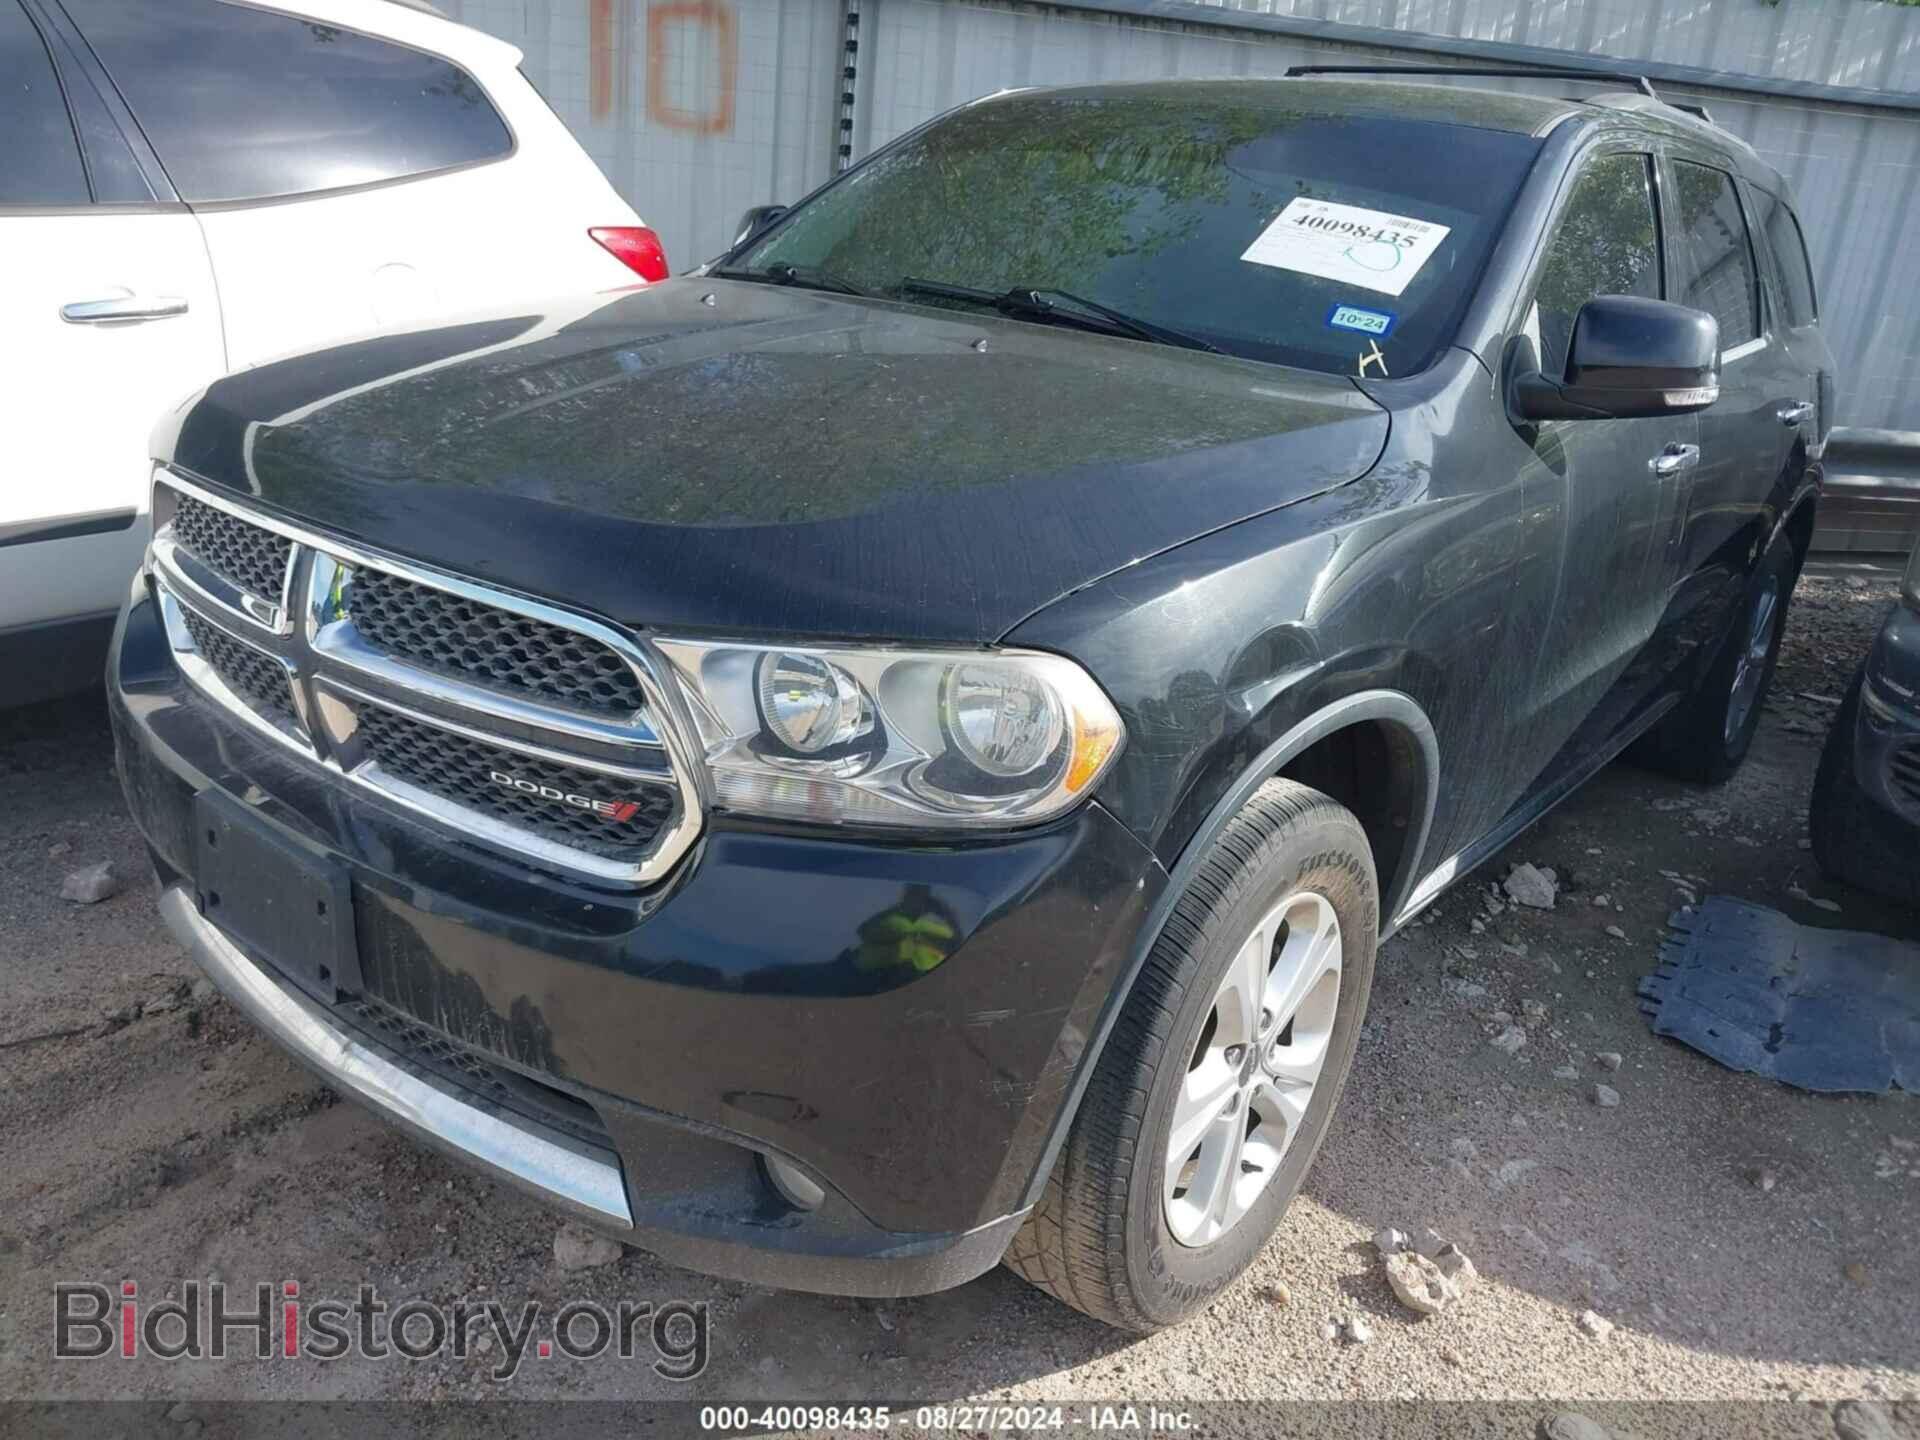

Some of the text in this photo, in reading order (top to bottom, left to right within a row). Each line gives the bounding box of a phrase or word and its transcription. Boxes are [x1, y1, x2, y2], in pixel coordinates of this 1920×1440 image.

[588, 0, 736, 137] 10
[1293, 214, 1418, 248] 40098435
[490, 771, 617, 815] DODGE
